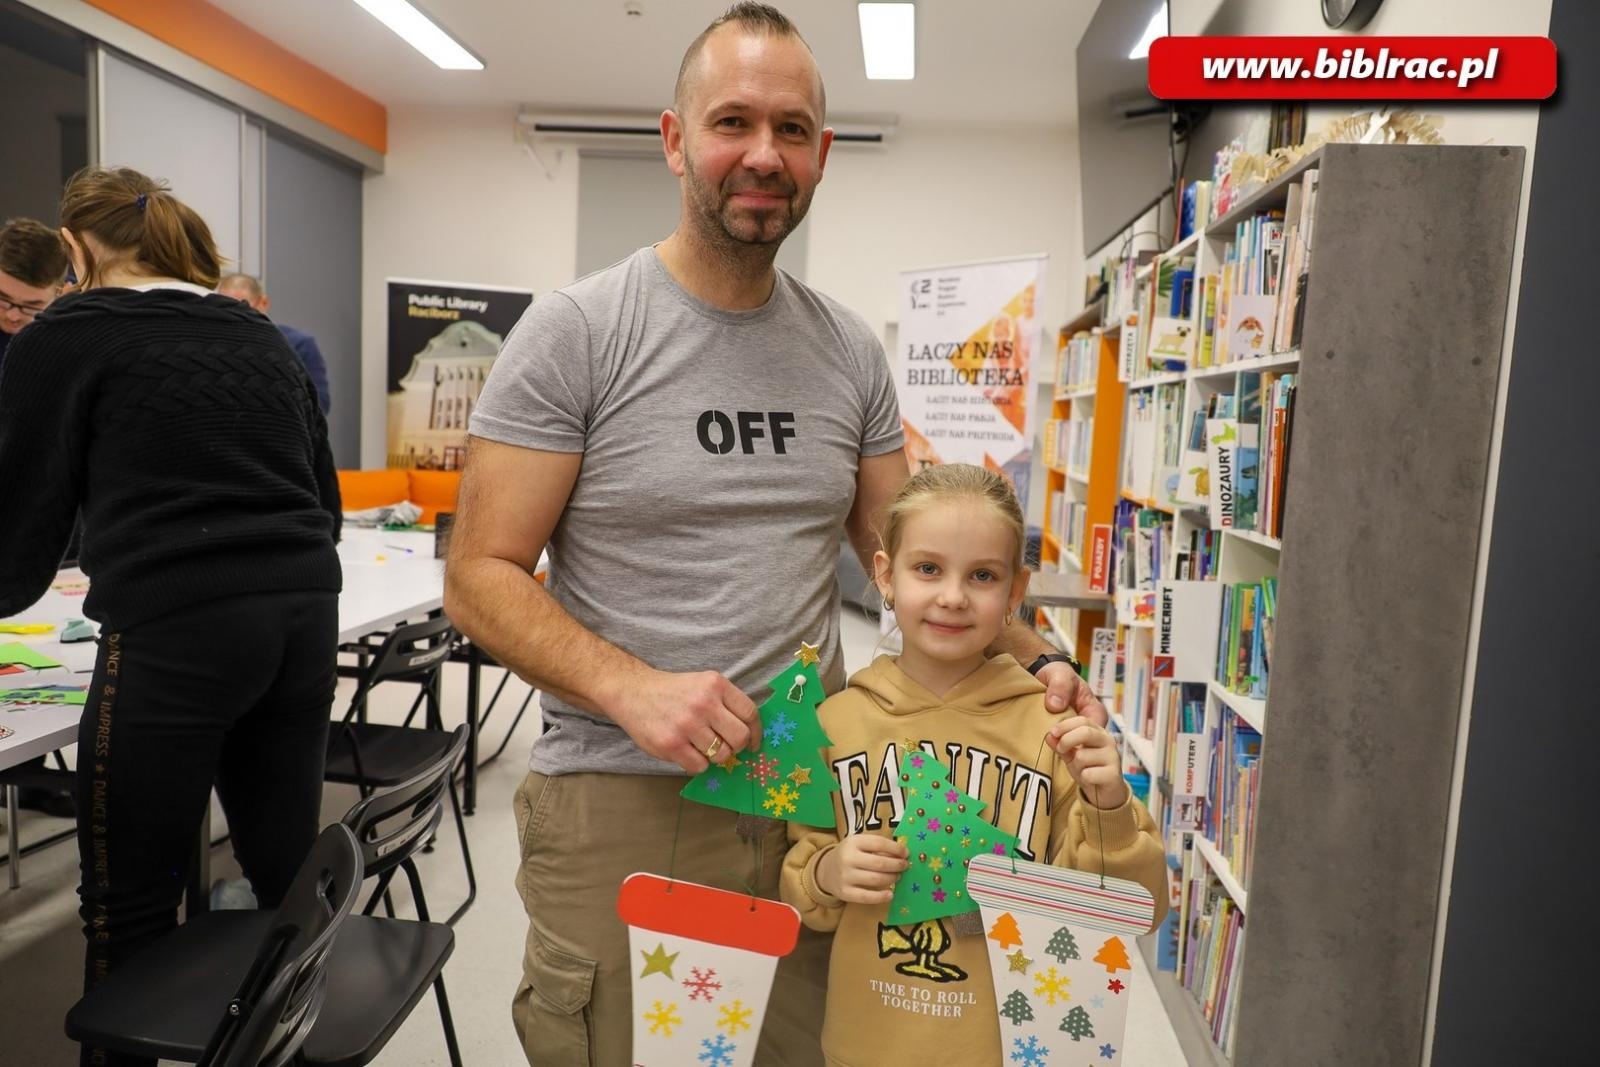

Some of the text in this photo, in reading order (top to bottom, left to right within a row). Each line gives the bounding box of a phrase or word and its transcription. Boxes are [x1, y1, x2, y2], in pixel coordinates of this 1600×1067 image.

[408, 293, 489, 313] Public Library
[908, 341, 1013, 361] ŁĄCZY NAS
[907, 368, 1024, 386] BIBLIOTEKA
[696, 409, 796, 455] OFF
[1218, 446, 1233, 527] DINOZAURY
[1094, 537, 1105, 579] POJAZDY
[1160, 587, 1173, 654] MINECRAFT
[107, 633, 120, 677] DANCE
[104, 684, 116, 696] &
[95, 701, 111, 757] IMPRESS
[1185, 739, 1196, 794] KOMPUTERY
[870, 979, 977, 1005] TIME TO ROLL
[881, 995, 962, 1018] TOGETHER
